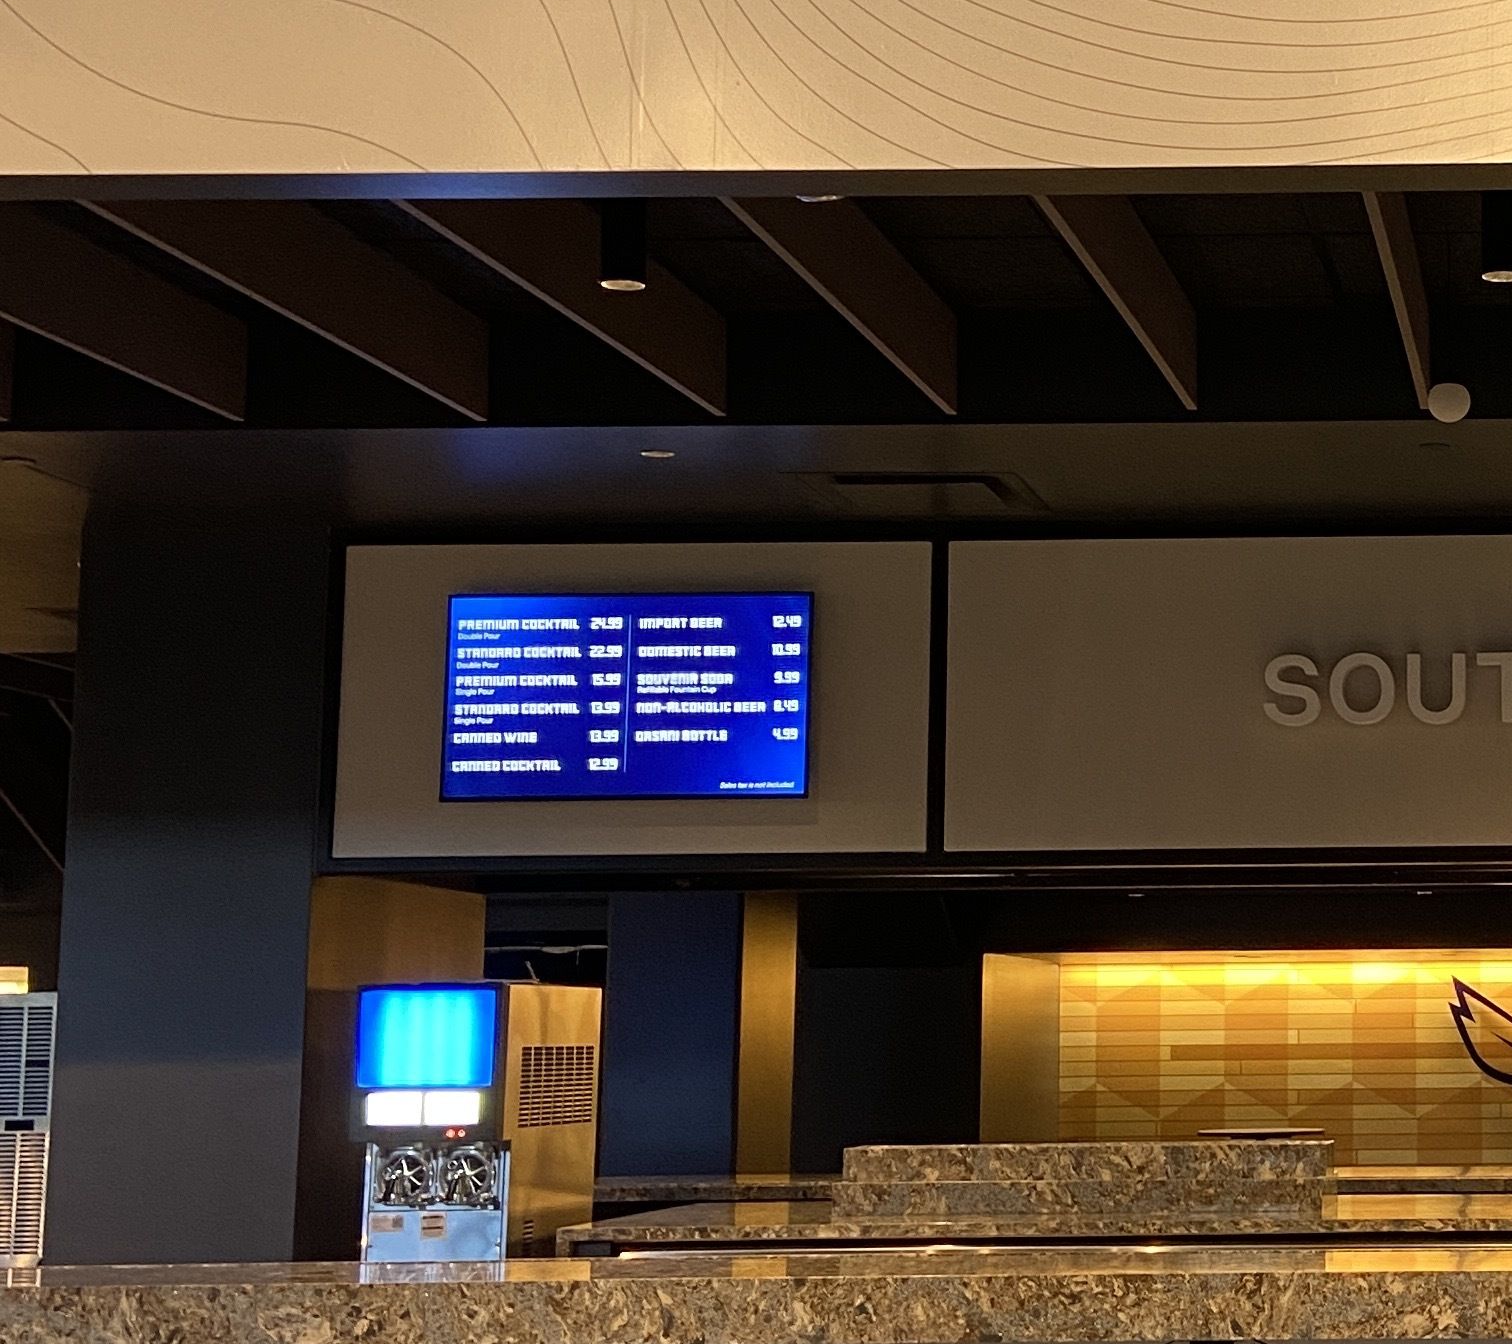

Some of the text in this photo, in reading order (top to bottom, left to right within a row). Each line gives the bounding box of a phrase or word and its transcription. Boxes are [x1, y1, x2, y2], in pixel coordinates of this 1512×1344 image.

[458, 617, 623, 630] PREMIUM COCKTAIL 24.99
[639, 615, 802, 629] IMPORT BEER 12.49
[457, 645, 622, 659] STANDARD COCKTAIL 22.99
[638, 643, 800, 657] DOMESTIC BEER 10.99
[456, 673, 621, 687] PREMIUM COCKTAIL 15.99
[637, 671, 800, 685] SOUVENIR SODA 9.99
[454, 701, 620, 715] STANDARD COCKTAIL 13.99
[636, 700, 799, 714] NON-ALCOHOLIC BEER 8.49
[453, 730, 619, 744] CANNED WINE 13.99
[635, 728, 798, 742] DASANI BOTTLE 4.99
[452, 758, 618, 772] CANNED COCKTAIL 12.99
